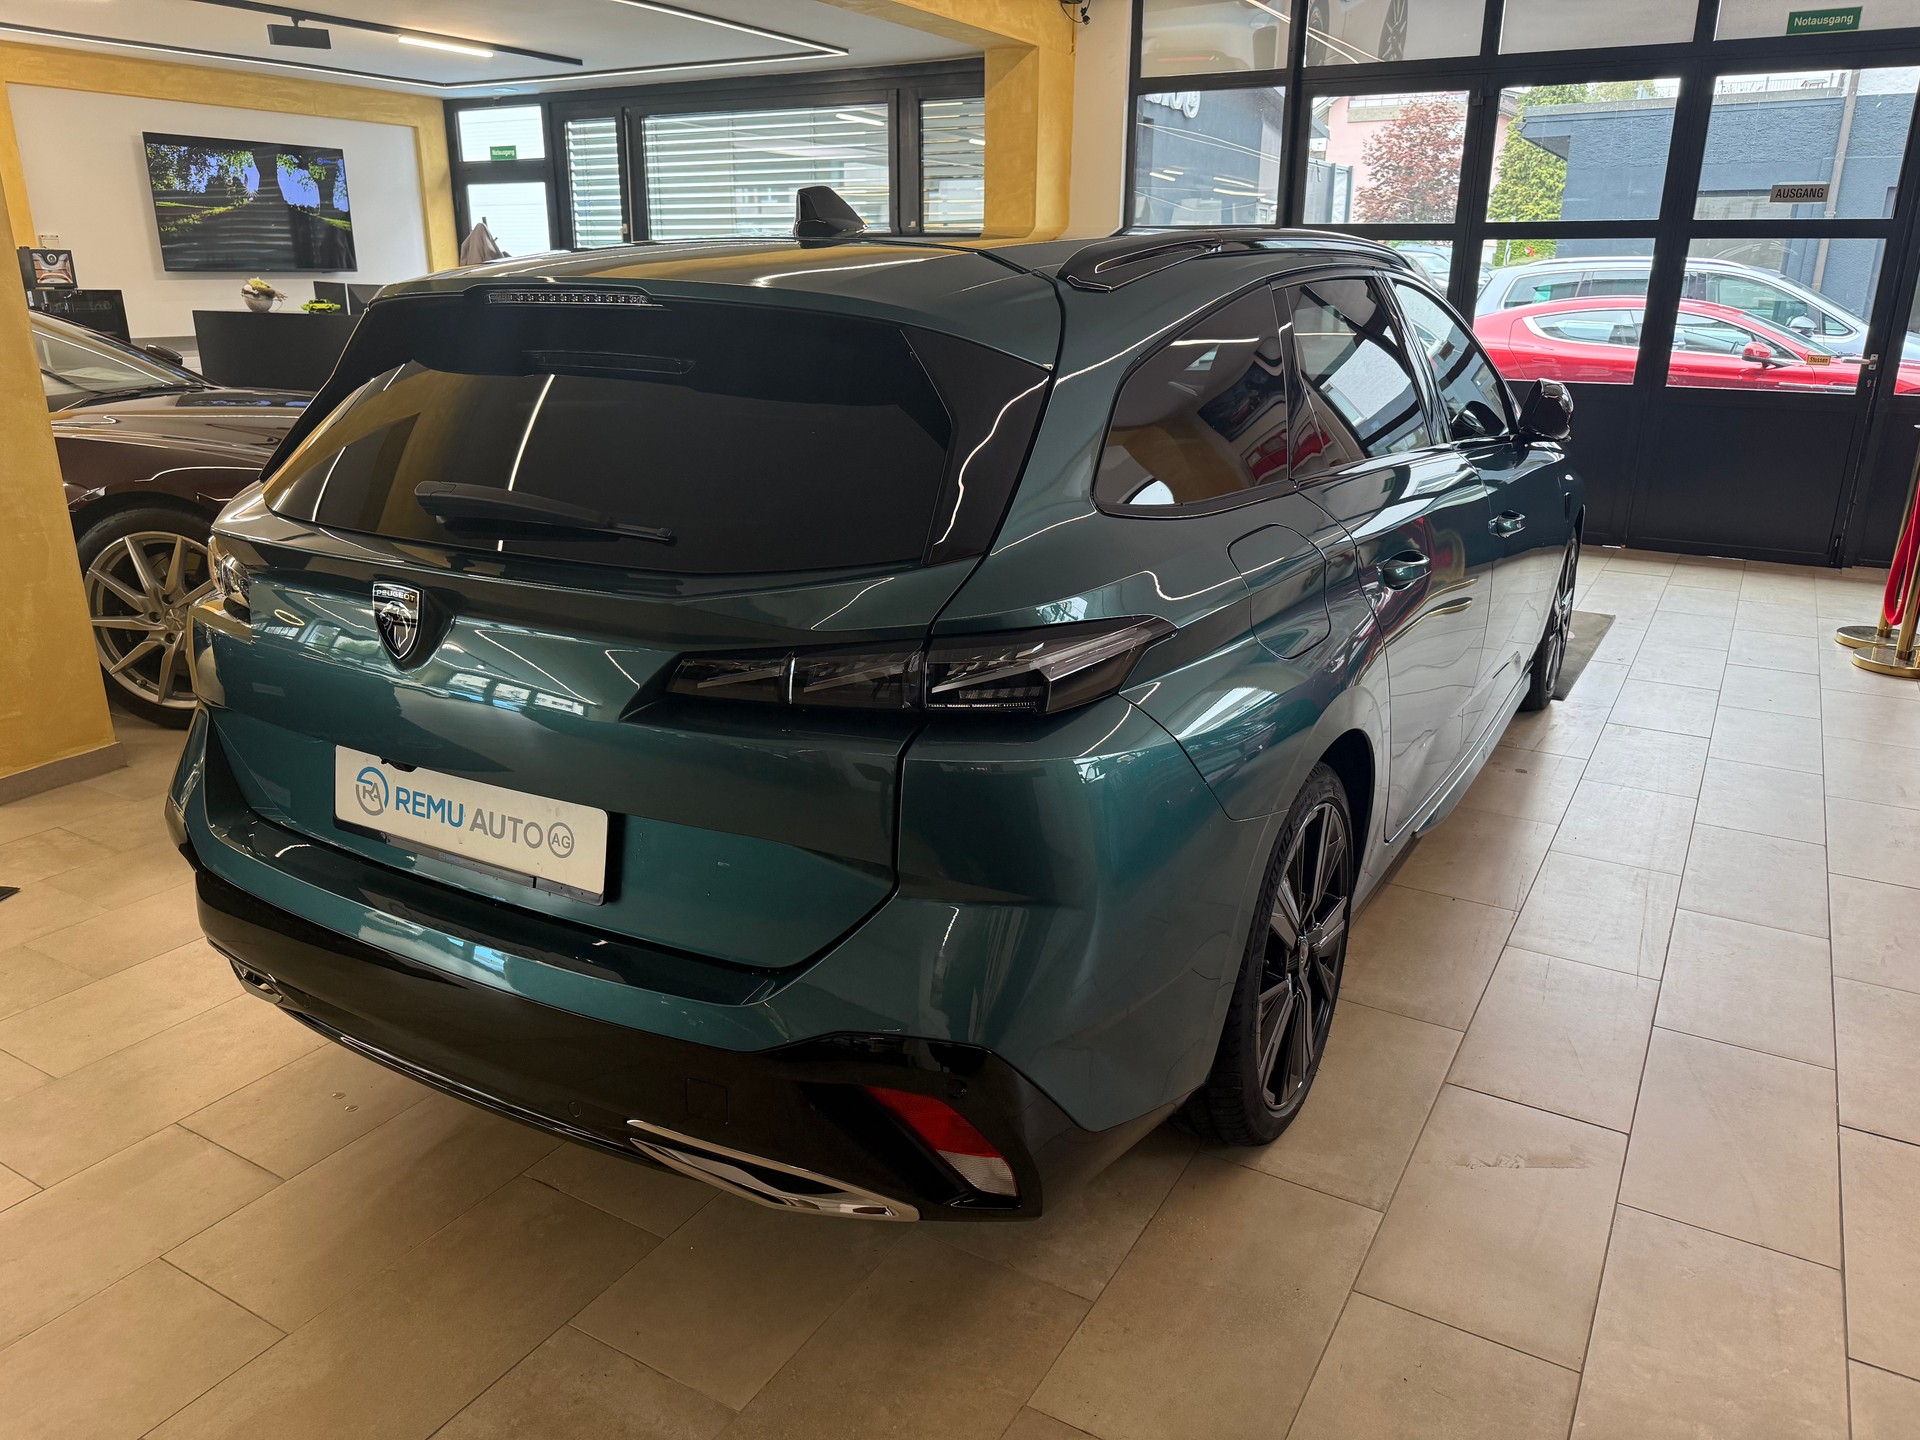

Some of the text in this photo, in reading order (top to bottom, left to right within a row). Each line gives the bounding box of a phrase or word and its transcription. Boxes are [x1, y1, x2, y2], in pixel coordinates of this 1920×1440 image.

[1793, 14, 1854, 27] Notausgang
[1775, 187, 1825, 199] AUSGANG
[376, 589, 415, 601] PEUGEOT
[395, 786, 571, 849] REMU AUTO AG
